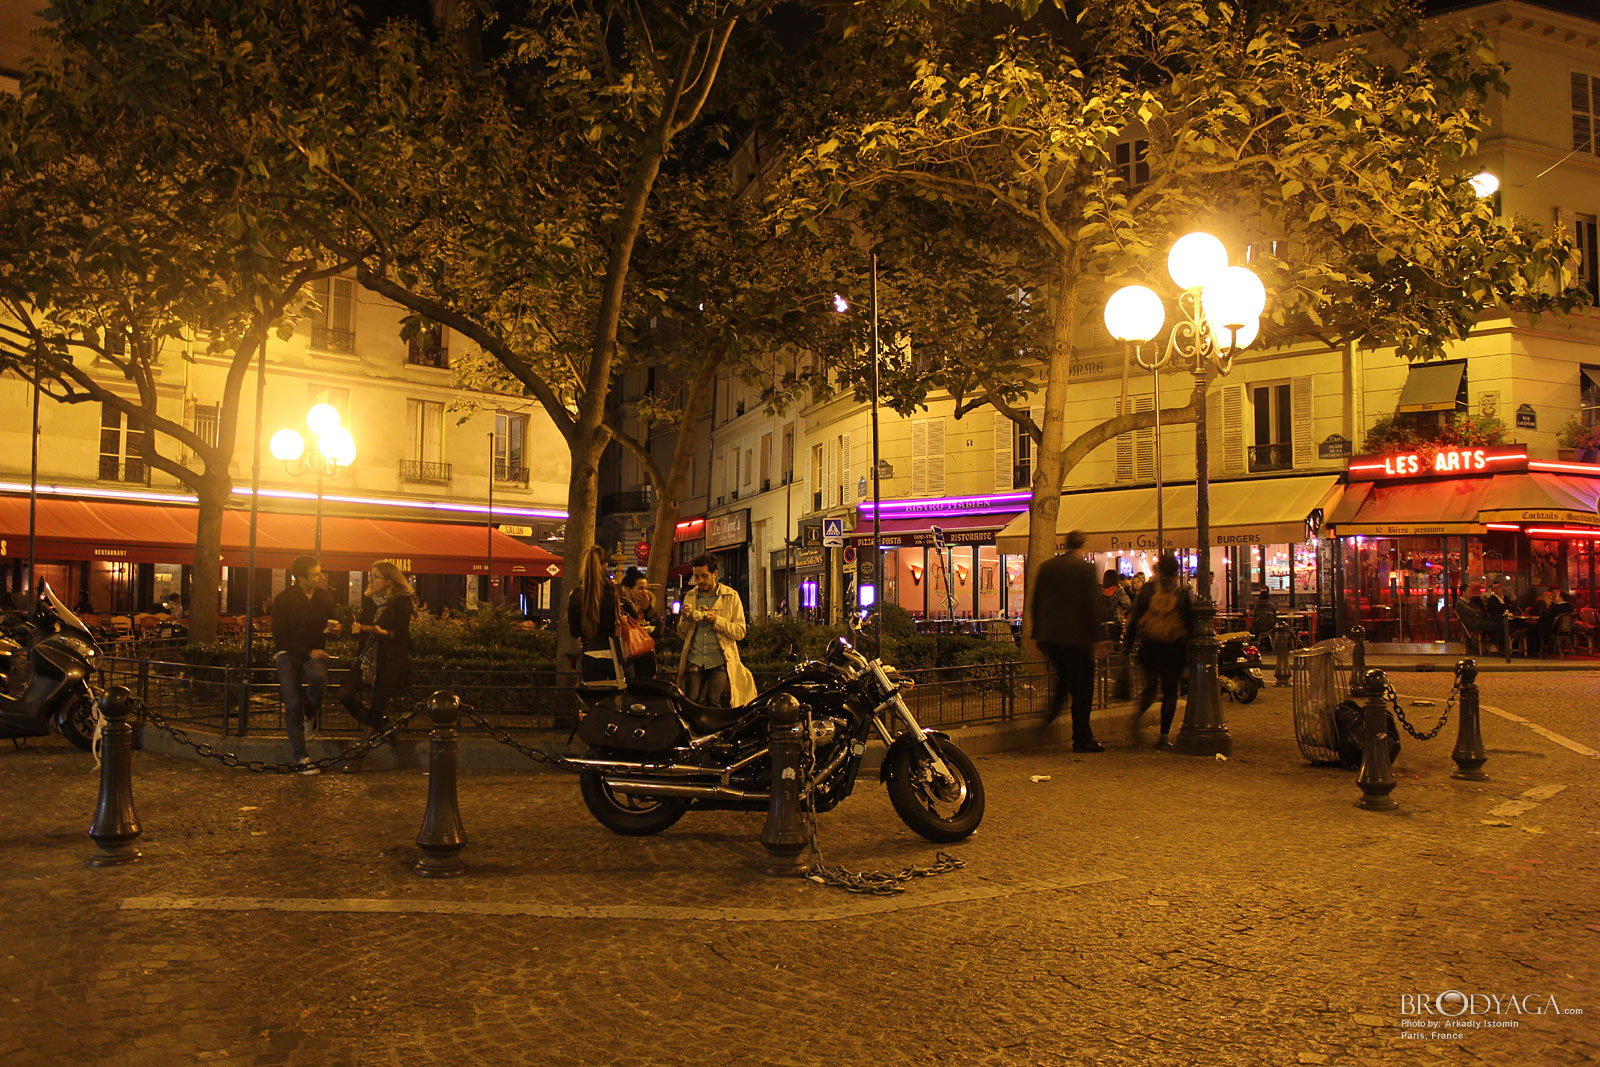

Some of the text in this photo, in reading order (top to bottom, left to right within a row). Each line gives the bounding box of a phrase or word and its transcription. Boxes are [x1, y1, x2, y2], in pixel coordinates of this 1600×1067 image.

[1385, 450, 1485, 475] LES ARTS
[905, 499, 991, 513] BISTRO ITALIEN
[1521, 511, 1558, 520] Cocktails
[505, 525, 523, 535] SALON
[882, 537, 901, 545] PASTA
[951, 532, 992, 543] RISTORANTE
[1217, 534, 1261, 544] BURGERS
